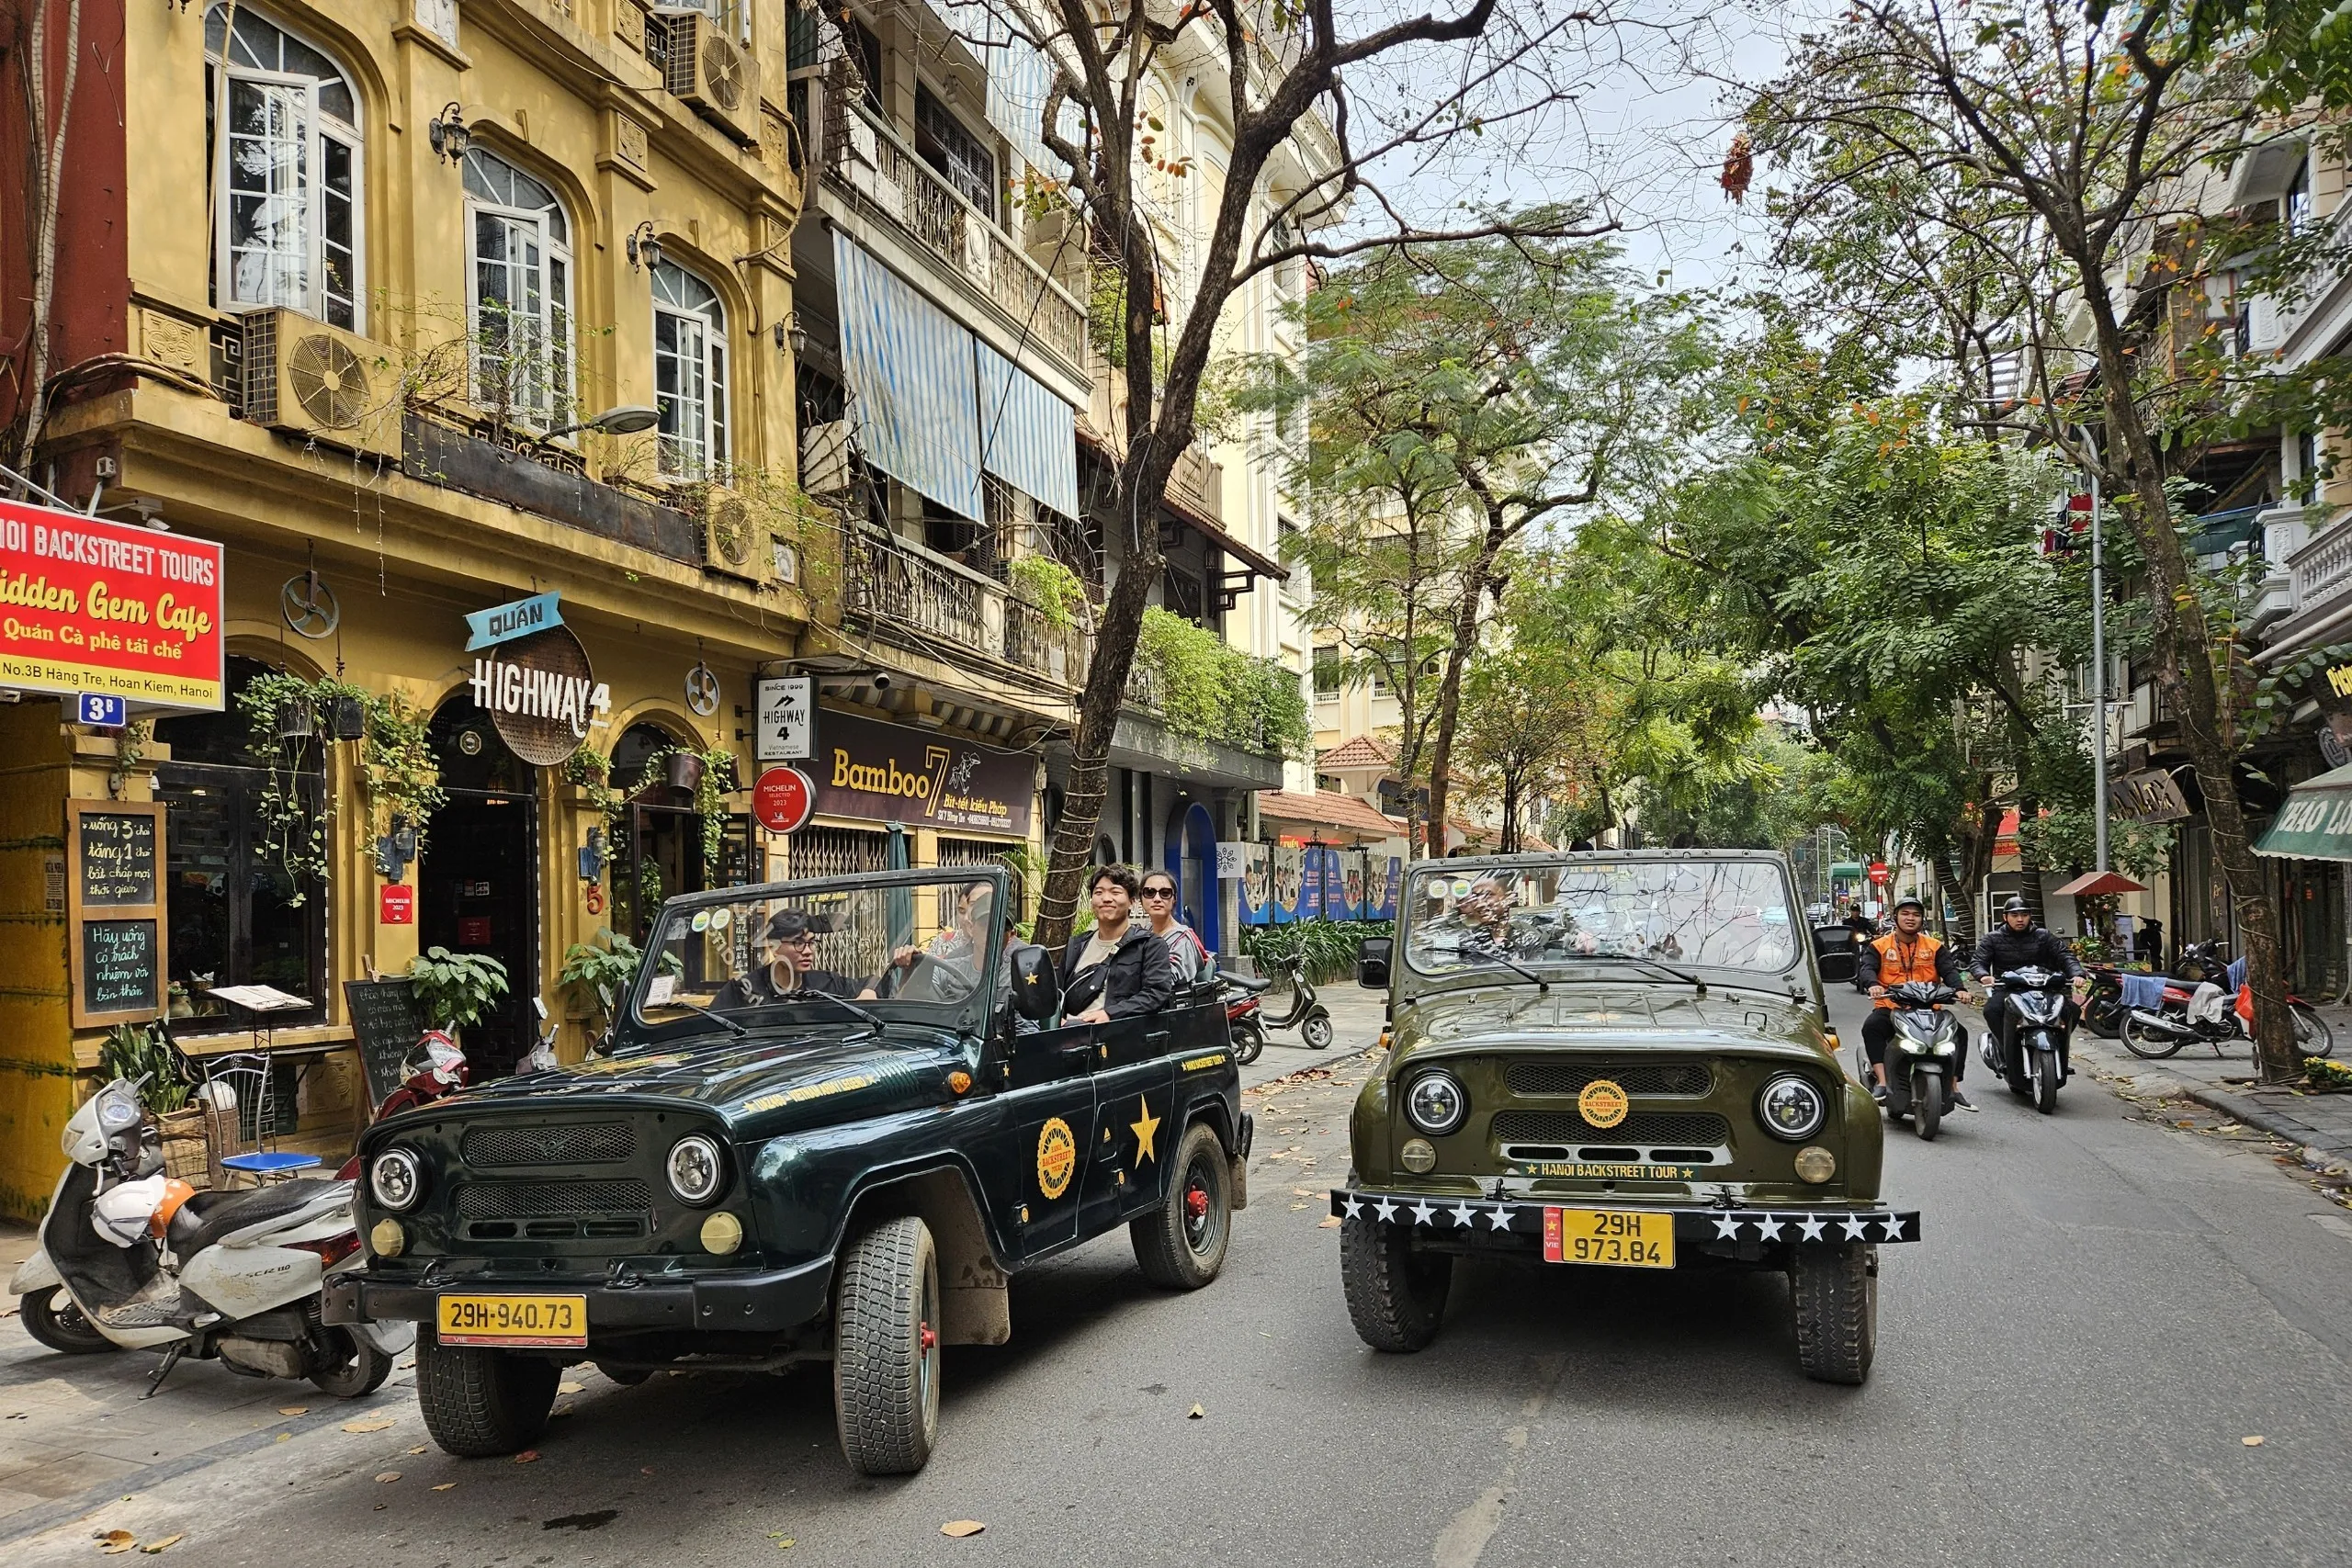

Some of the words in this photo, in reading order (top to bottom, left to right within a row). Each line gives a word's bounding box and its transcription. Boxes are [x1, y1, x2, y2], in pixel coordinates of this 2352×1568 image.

[34, 525, 154, 576] BACKSTREET
[160, 550, 213, 586] TOURS
[0, 568, 79, 614] idden
[87, 581, 150, 625] Gem
[157, 593, 212, 642] Cafe
[489, 603, 543, 637] QUÁN
[4, 617, 54, 641] Quán
[60, 626, 84, 645] Cà
[90, 631, 121, 651] phê
[126, 638, 148, 654] tái
[153, 641, 183, 659] chế
[3, 662, 41, 678] No.3B
[46, 668, 78, 685] Hàng
[84, 672, 106, 686] Tre,
[109, 676, 140, 690] Hoan
[144, 680, 176, 696] Kiem,
[181, 685, 212, 698] Hanoi
[469, 659, 591, 739] HIGHWAY
[589, 682, 612, 716] 4
[763, 709, 805, 727] HIGHWAY
[777, 727, 789, 740] 4
[831, 749, 929, 798] Bamboo
[924, 745, 950, 817] 7
[988, 801, 1007, 818] Pháp
[89, 816, 119, 838] uống
[122, 820, 133, 840] 3
[124, 843, 132, 860] 1
[587, 883, 604, 915] 5
[93, 927, 119, 950] Hãy
[122, 925, 145, 950] uống
[111, 944, 139, 963] trách
[96, 964, 133, 982] nhiệm
[134, 964, 149, 978] với
[119, 984, 144, 997] thân
[1042, 1150, 1071, 1167] BACKSTREET
[1541, 1163, 1575, 1177] HANOI
[1577, 1165, 1645, 1179] BACKSTREET
[1648, 1166, 1678, 1179] TOUR
[1594, 1213, 1641, 1237] 29H
[1575, 1237, 1661, 1264] 973.84
[450, 1303, 571, 1329] 29H-940.73
